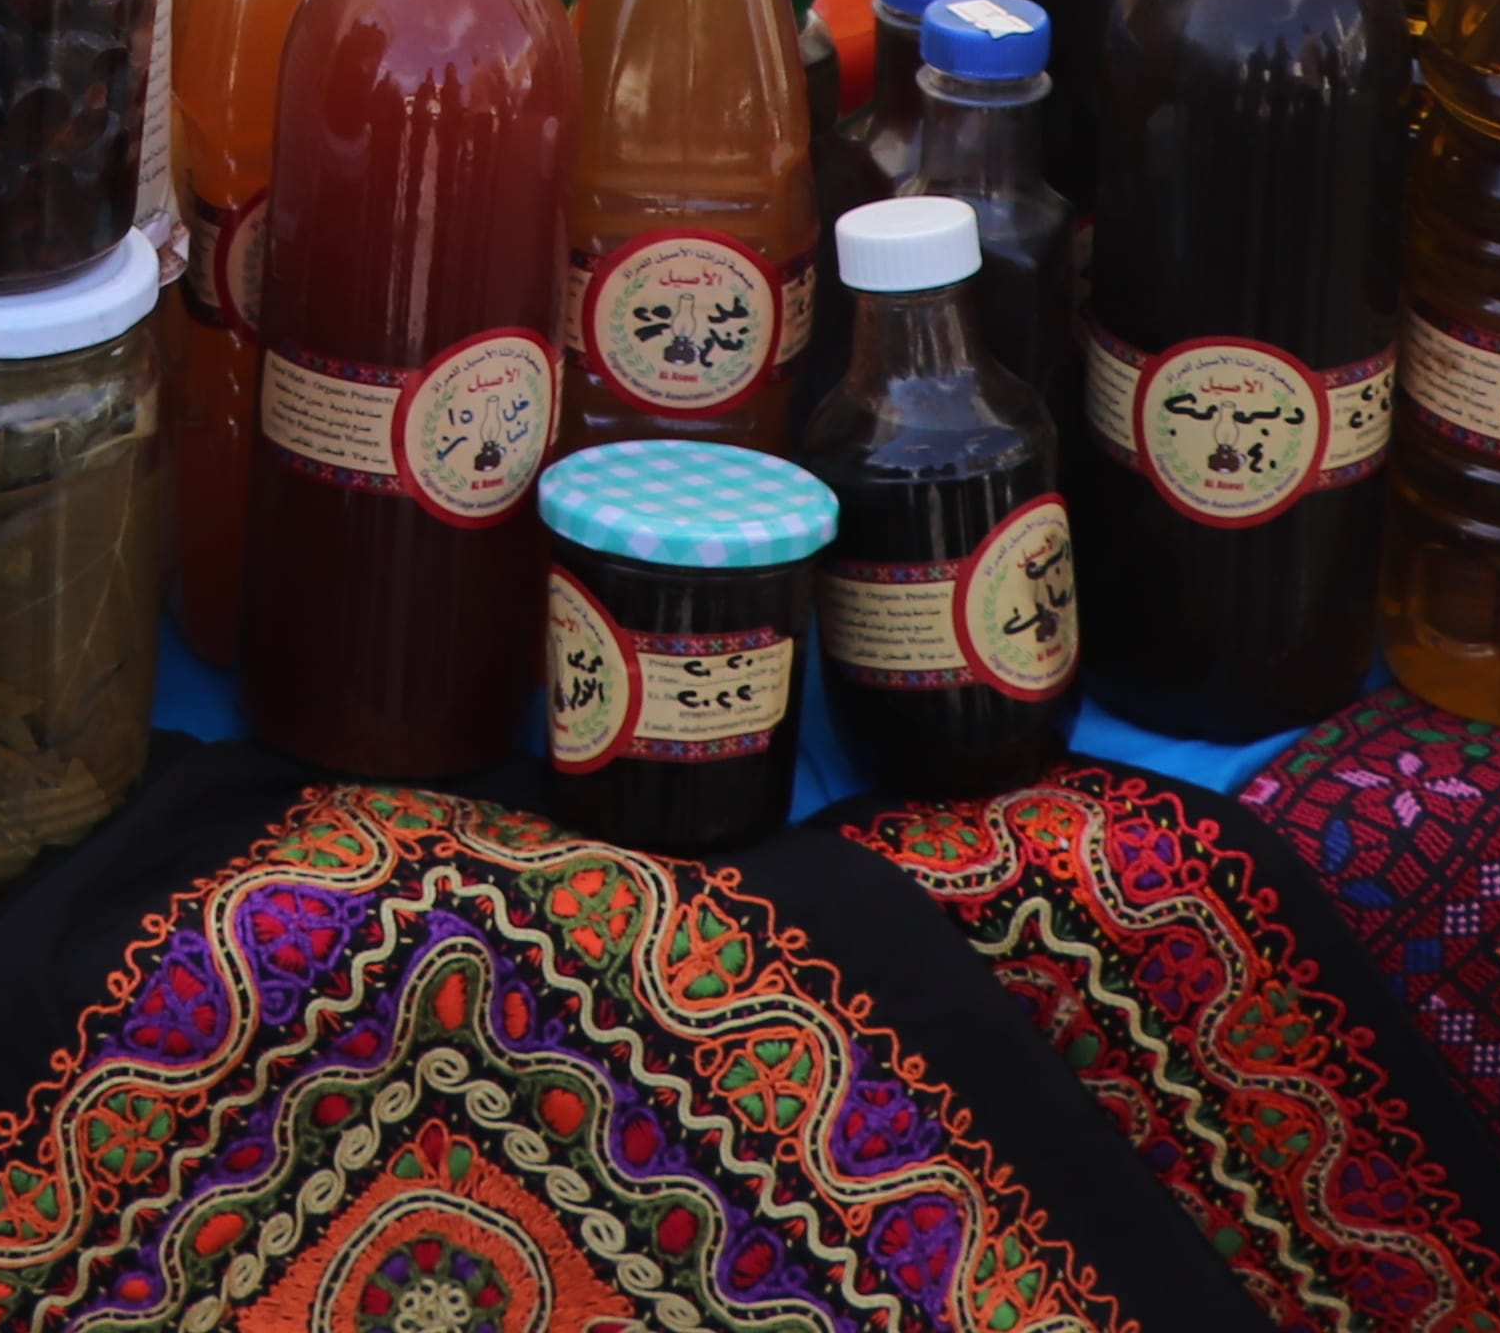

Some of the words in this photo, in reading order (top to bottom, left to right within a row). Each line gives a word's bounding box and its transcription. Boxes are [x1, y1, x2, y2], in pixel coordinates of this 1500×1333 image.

[657, 268, 724, 288] الأصيل
[468, 365, 521, 393] الأصيل
[1199, 376, 1264, 395] الأصيل
